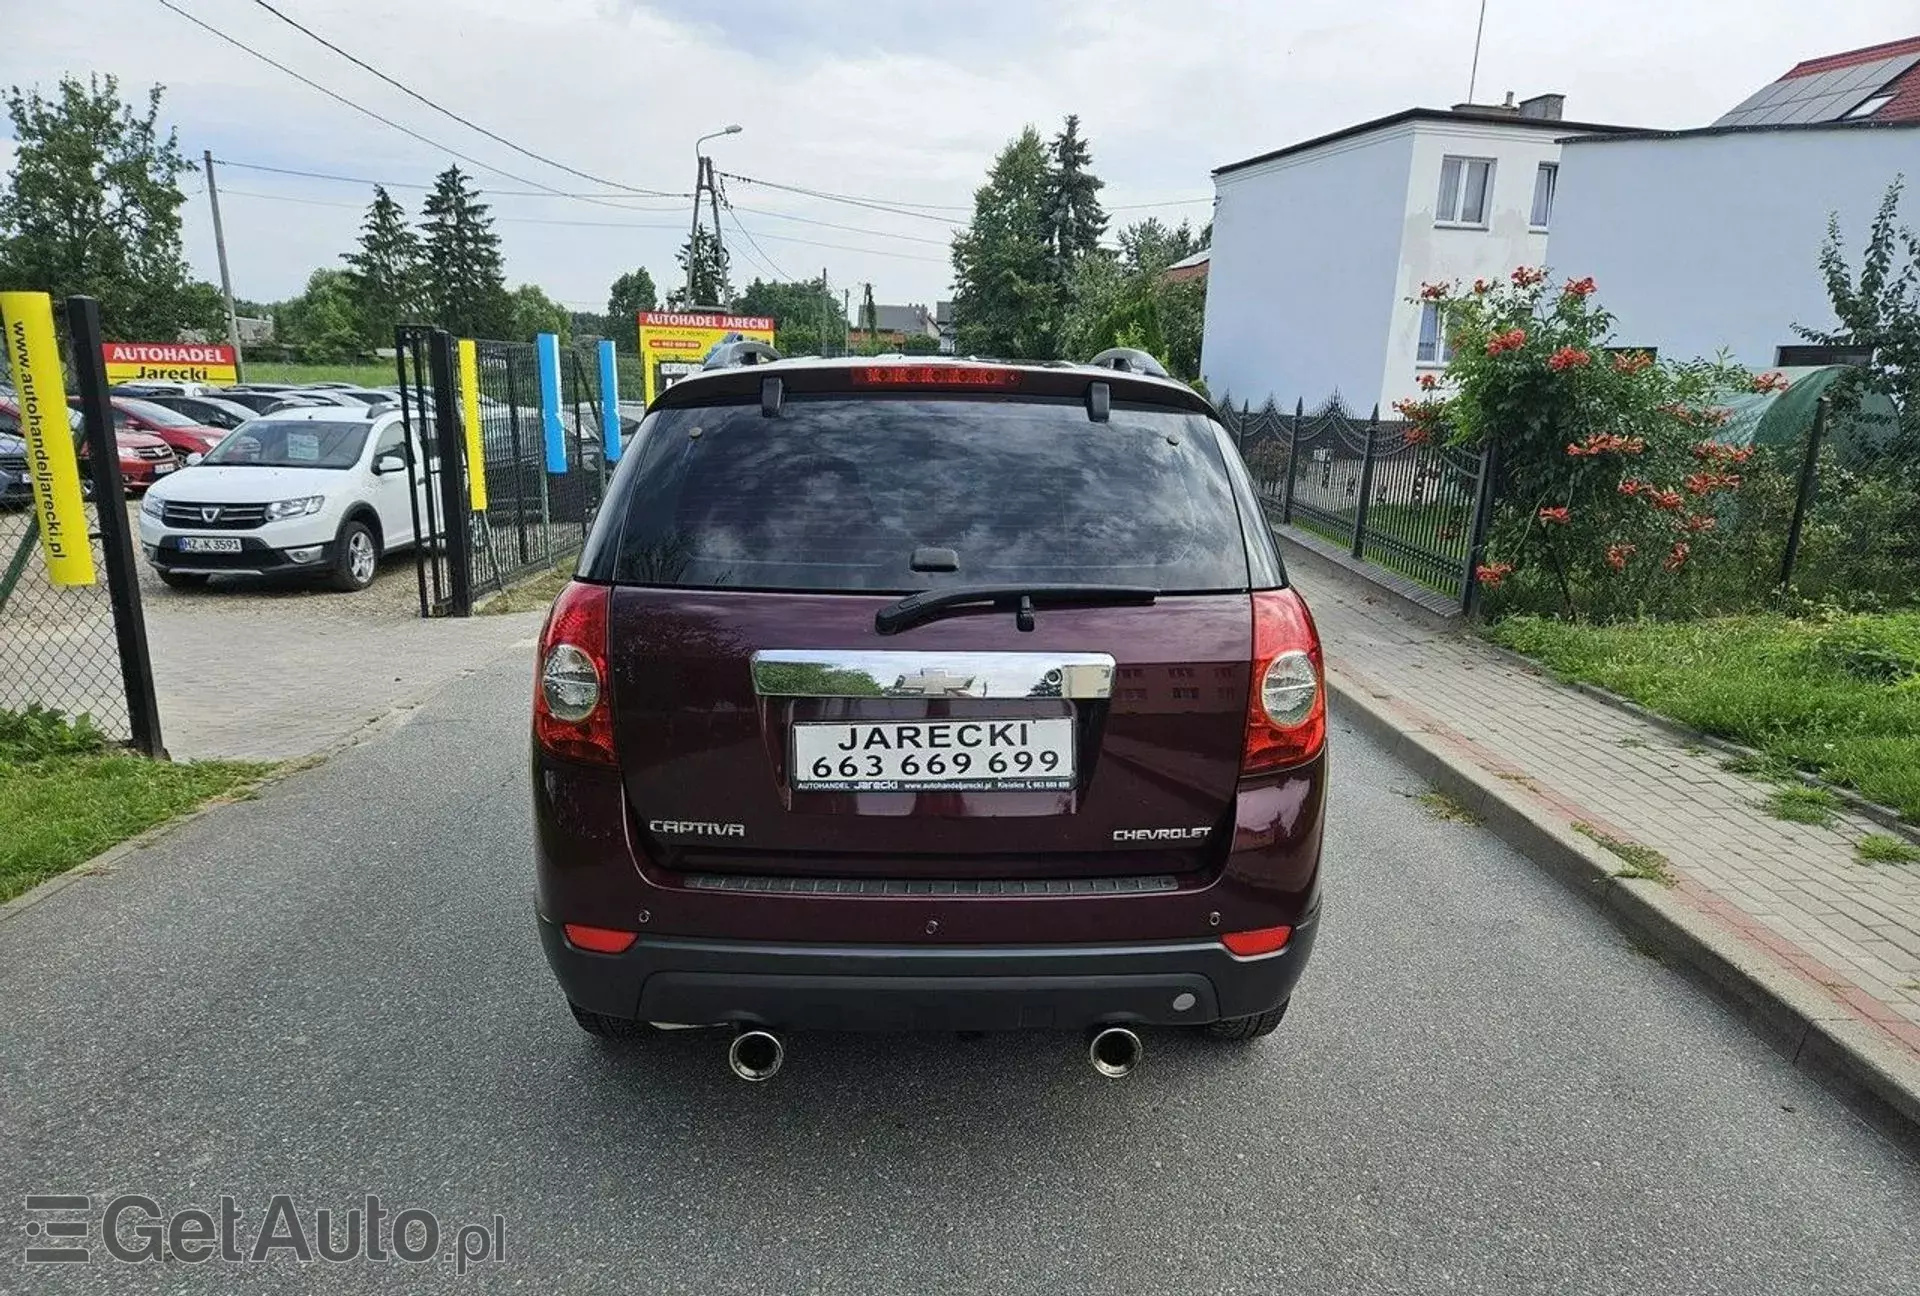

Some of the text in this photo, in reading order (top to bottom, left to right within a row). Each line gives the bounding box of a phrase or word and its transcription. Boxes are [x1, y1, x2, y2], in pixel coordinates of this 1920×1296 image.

[646, 313, 770, 330] AUTOHADEL JARECKI
[112, 346, 227, 363] AUTOHADEL
[135, 366, 208, 380] Jarecki
[12, 321, 67, 559] www.autohandeljarecki.pl
[838, 723, 1028, 751] JARECKI
[812, 750, 1060, 778] 663 669 699
[798, 782, 850, 790] AUTOHANDEL
[853, 780, 899, 790] Jarecki
[649, 820, 746, 838] CAPTIVA
[1113, 826, 1213, 841] CHEVROLET
